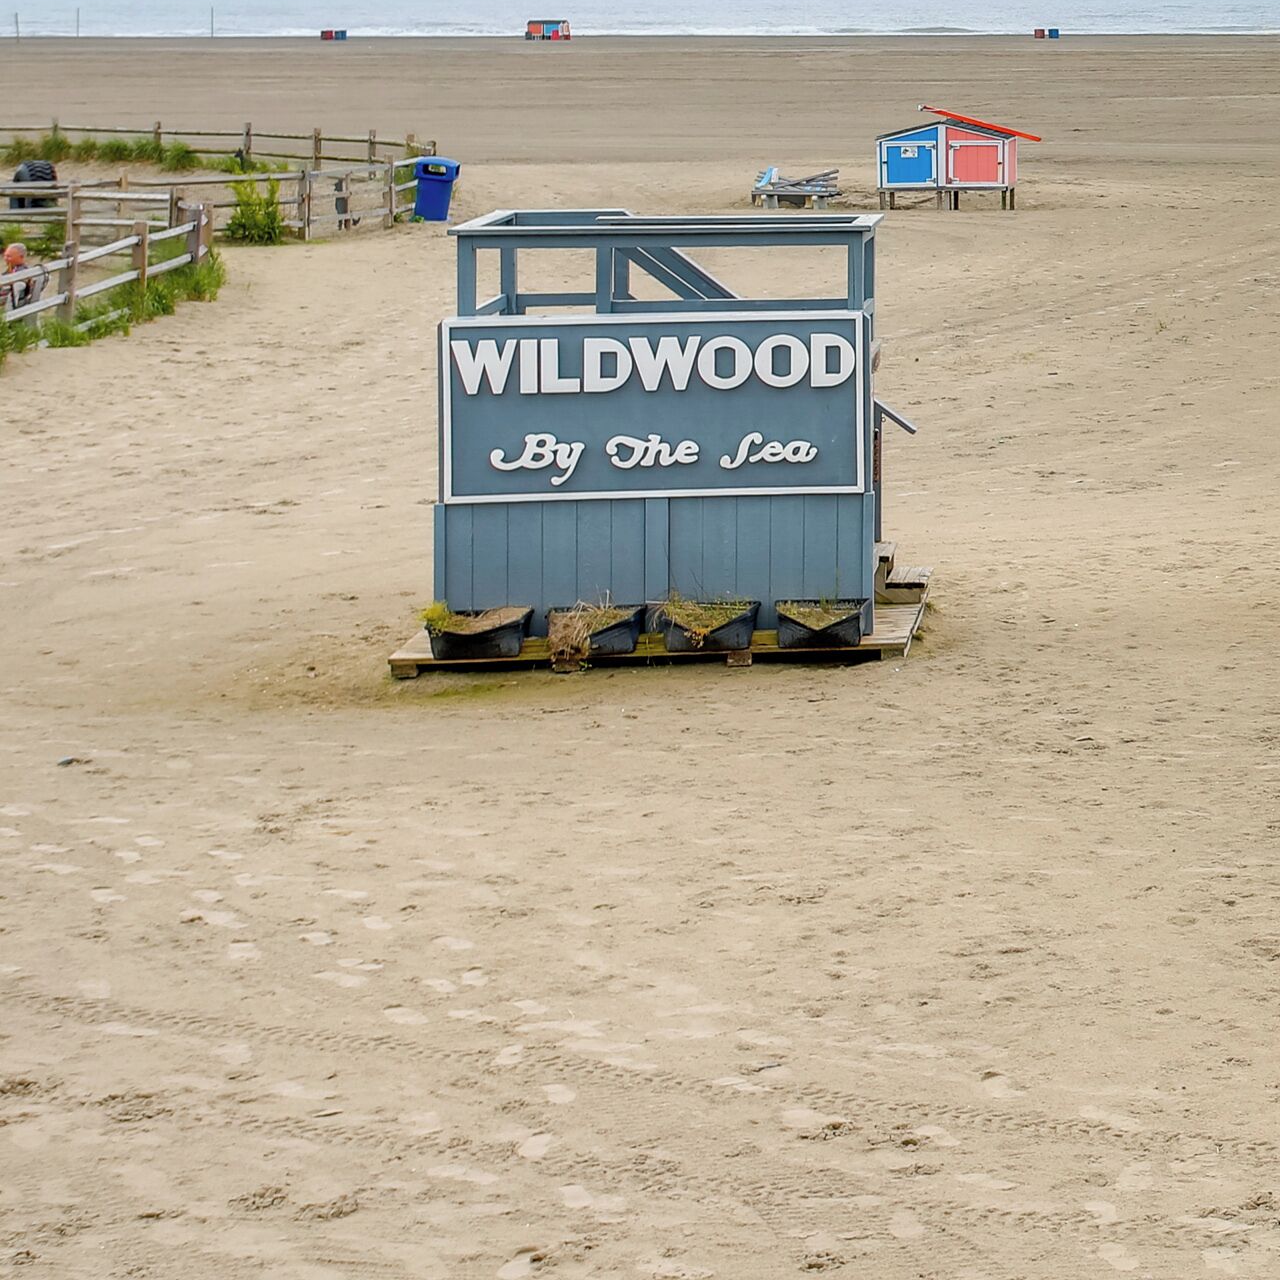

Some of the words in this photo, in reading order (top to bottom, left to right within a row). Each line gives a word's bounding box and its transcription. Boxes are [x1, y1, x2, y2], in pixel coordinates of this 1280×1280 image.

[450, 332, 856, 396] WILDWOOD
[489, 433, 585, 486] By
[605, 433, 699, 469] The
[719, 431, 818, 470] Sea
